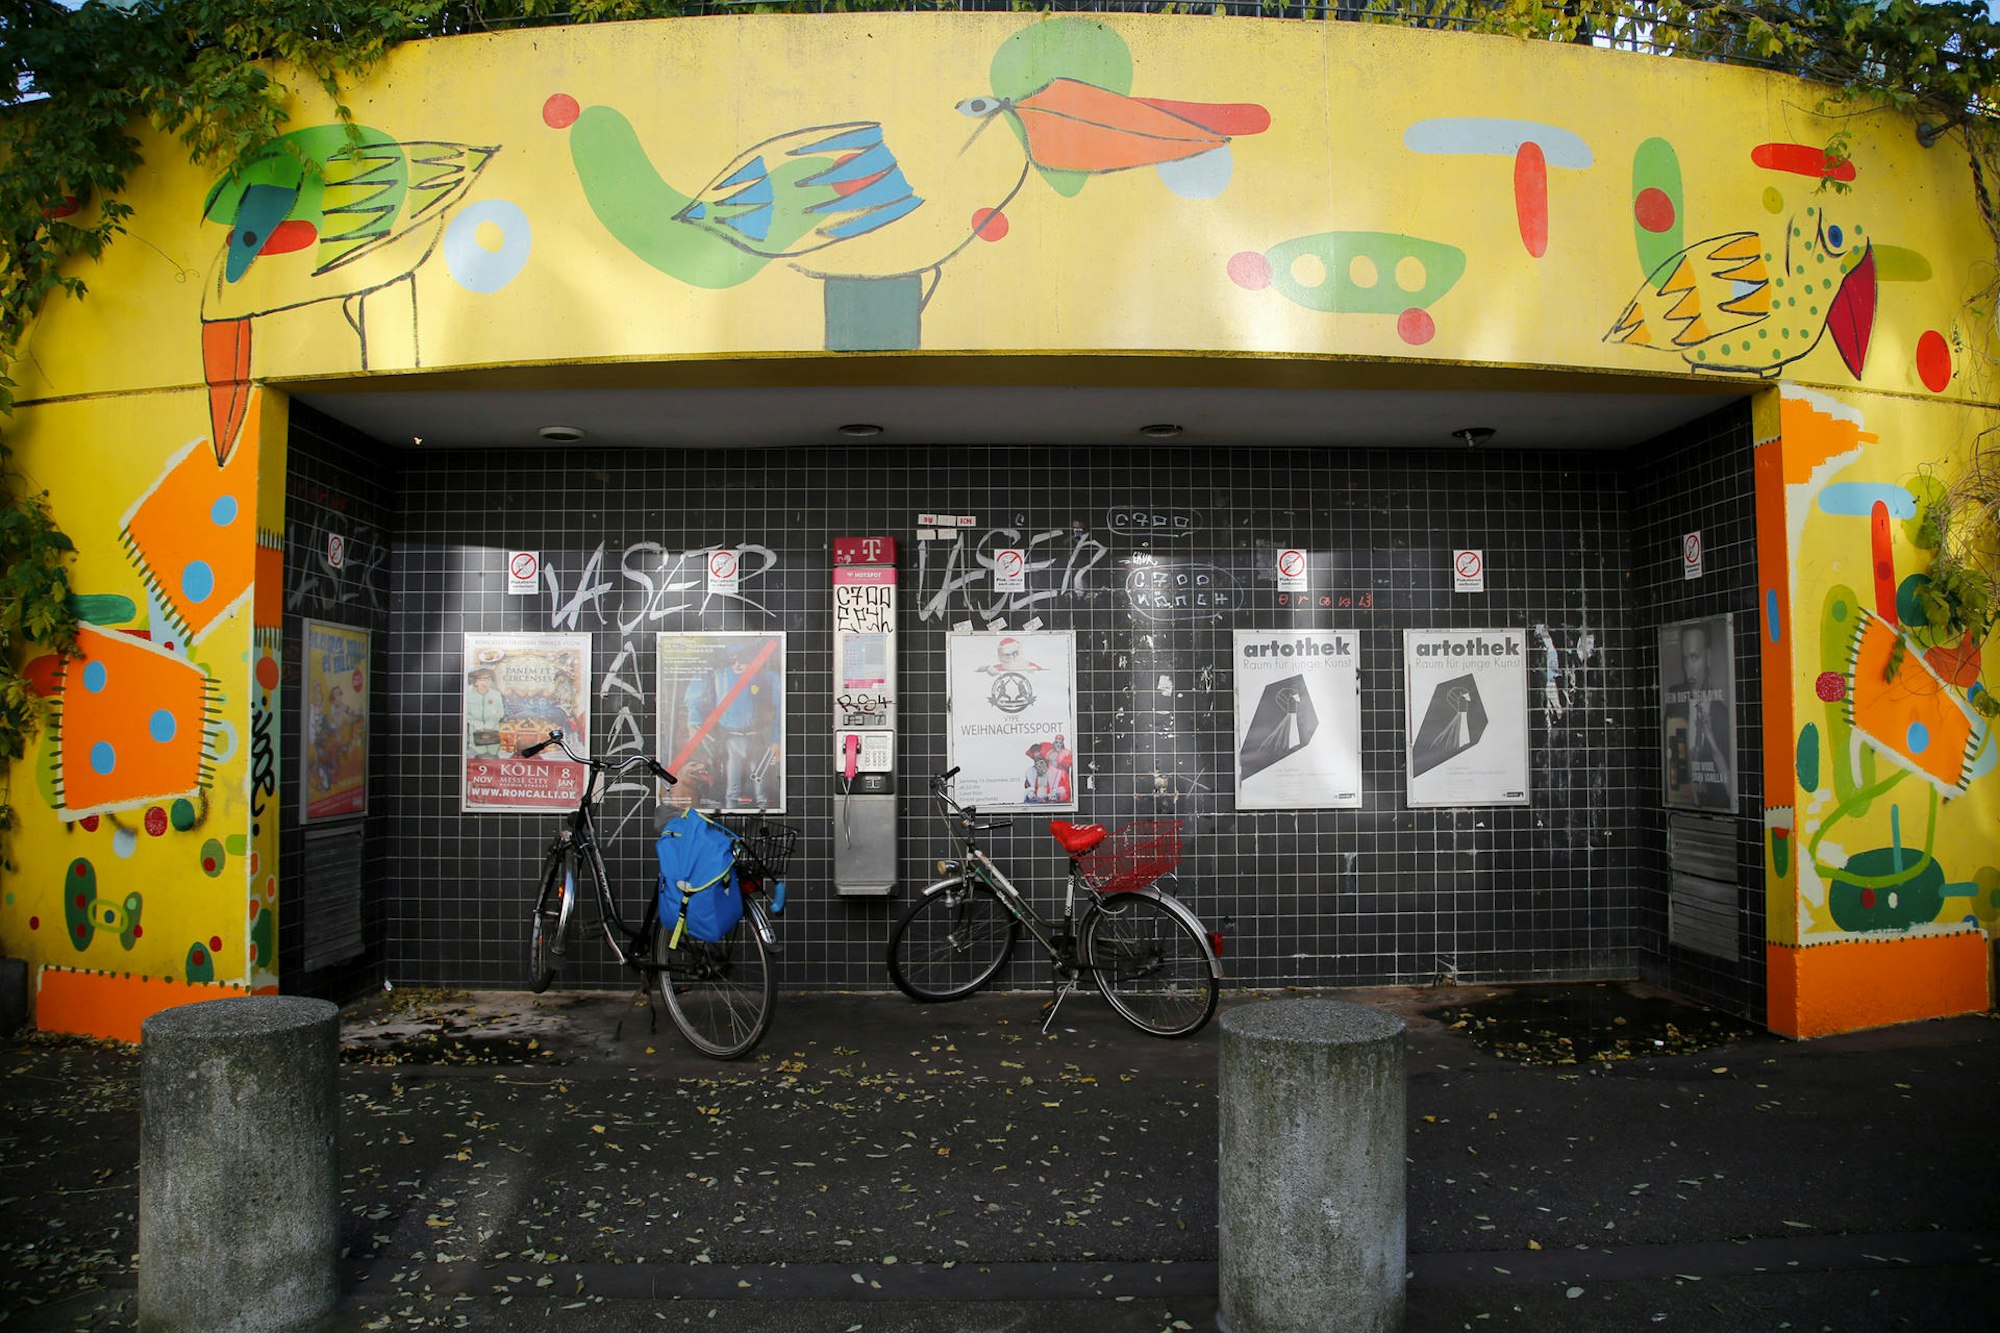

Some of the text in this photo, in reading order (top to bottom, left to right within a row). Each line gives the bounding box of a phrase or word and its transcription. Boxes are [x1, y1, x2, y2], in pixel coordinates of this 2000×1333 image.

[1243, 637, 1351, 658] artothek
[1416, 637, 1520, 657] artothek
[1243, 657, 1352, 672] Raum für junge Kunst
[1415, 657, 1520, 671] Raum für junge Kunst
[506, 667, 537, 675] PANEM
[503, 675, 553, 683] CIRCENSES
[961, 722, 1063, 736] WEIHNACHTSSPORT
[478, 765, 488, 776] 9
[500, 762, 549, 777] KÖLN
[562, 768, 571, 778] 8
[473, 776, 493, 784] NOV
[558, 779, 574, 787] JAN
[472, 787, 576, 799] WWW.RONCALLI.DE
